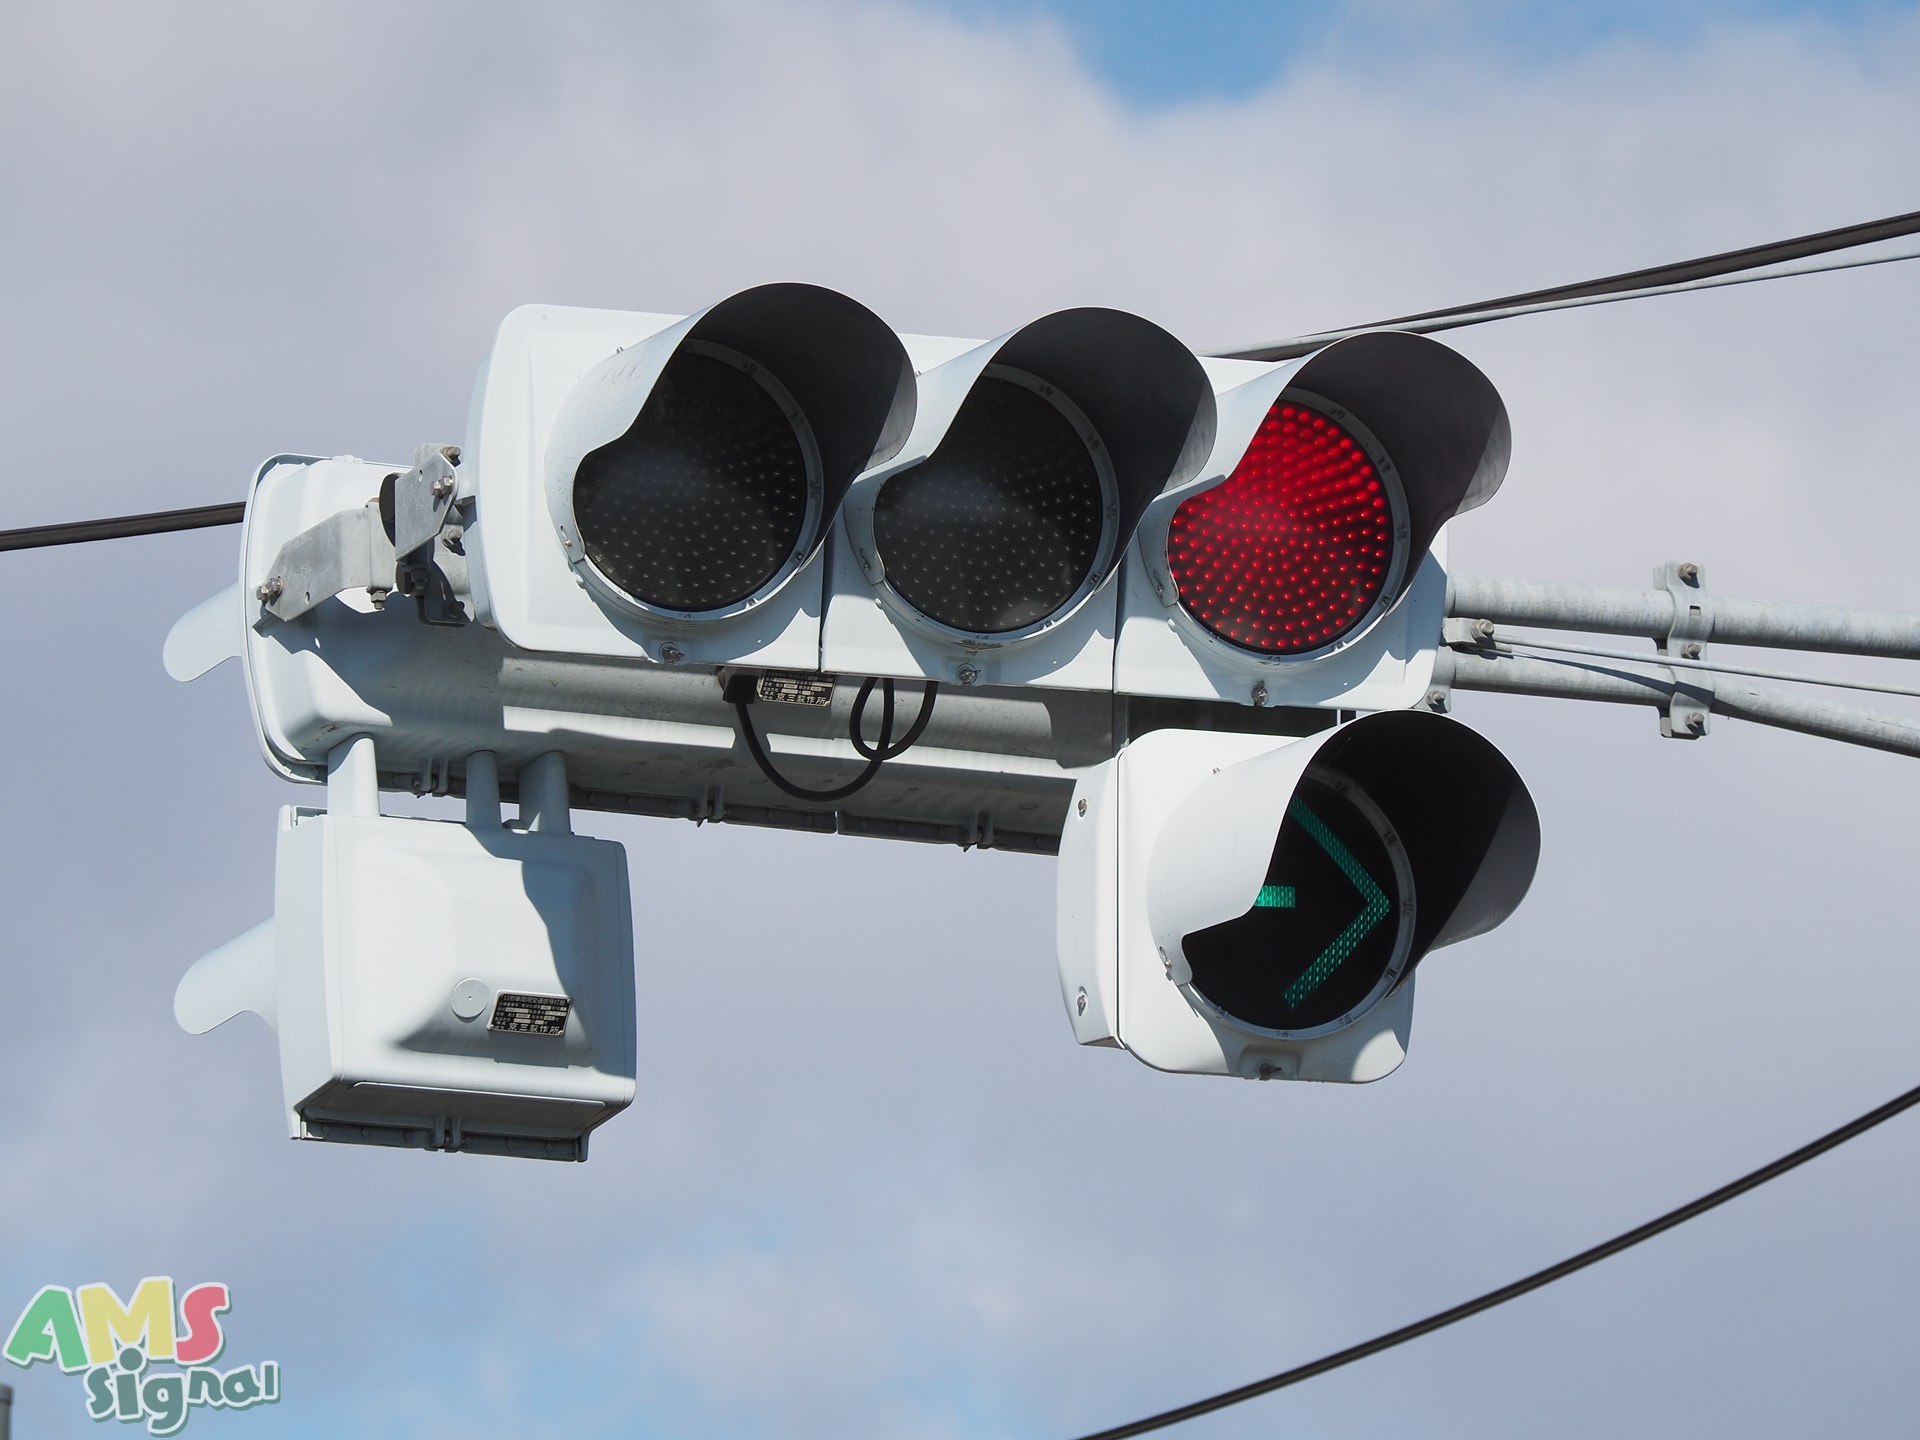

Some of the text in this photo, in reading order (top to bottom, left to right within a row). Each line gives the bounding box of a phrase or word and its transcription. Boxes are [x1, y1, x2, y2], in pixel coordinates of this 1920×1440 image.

[776, 693, 826, 705] 京三製作所
[508, 1022, 560, 1034] 京三製作所
